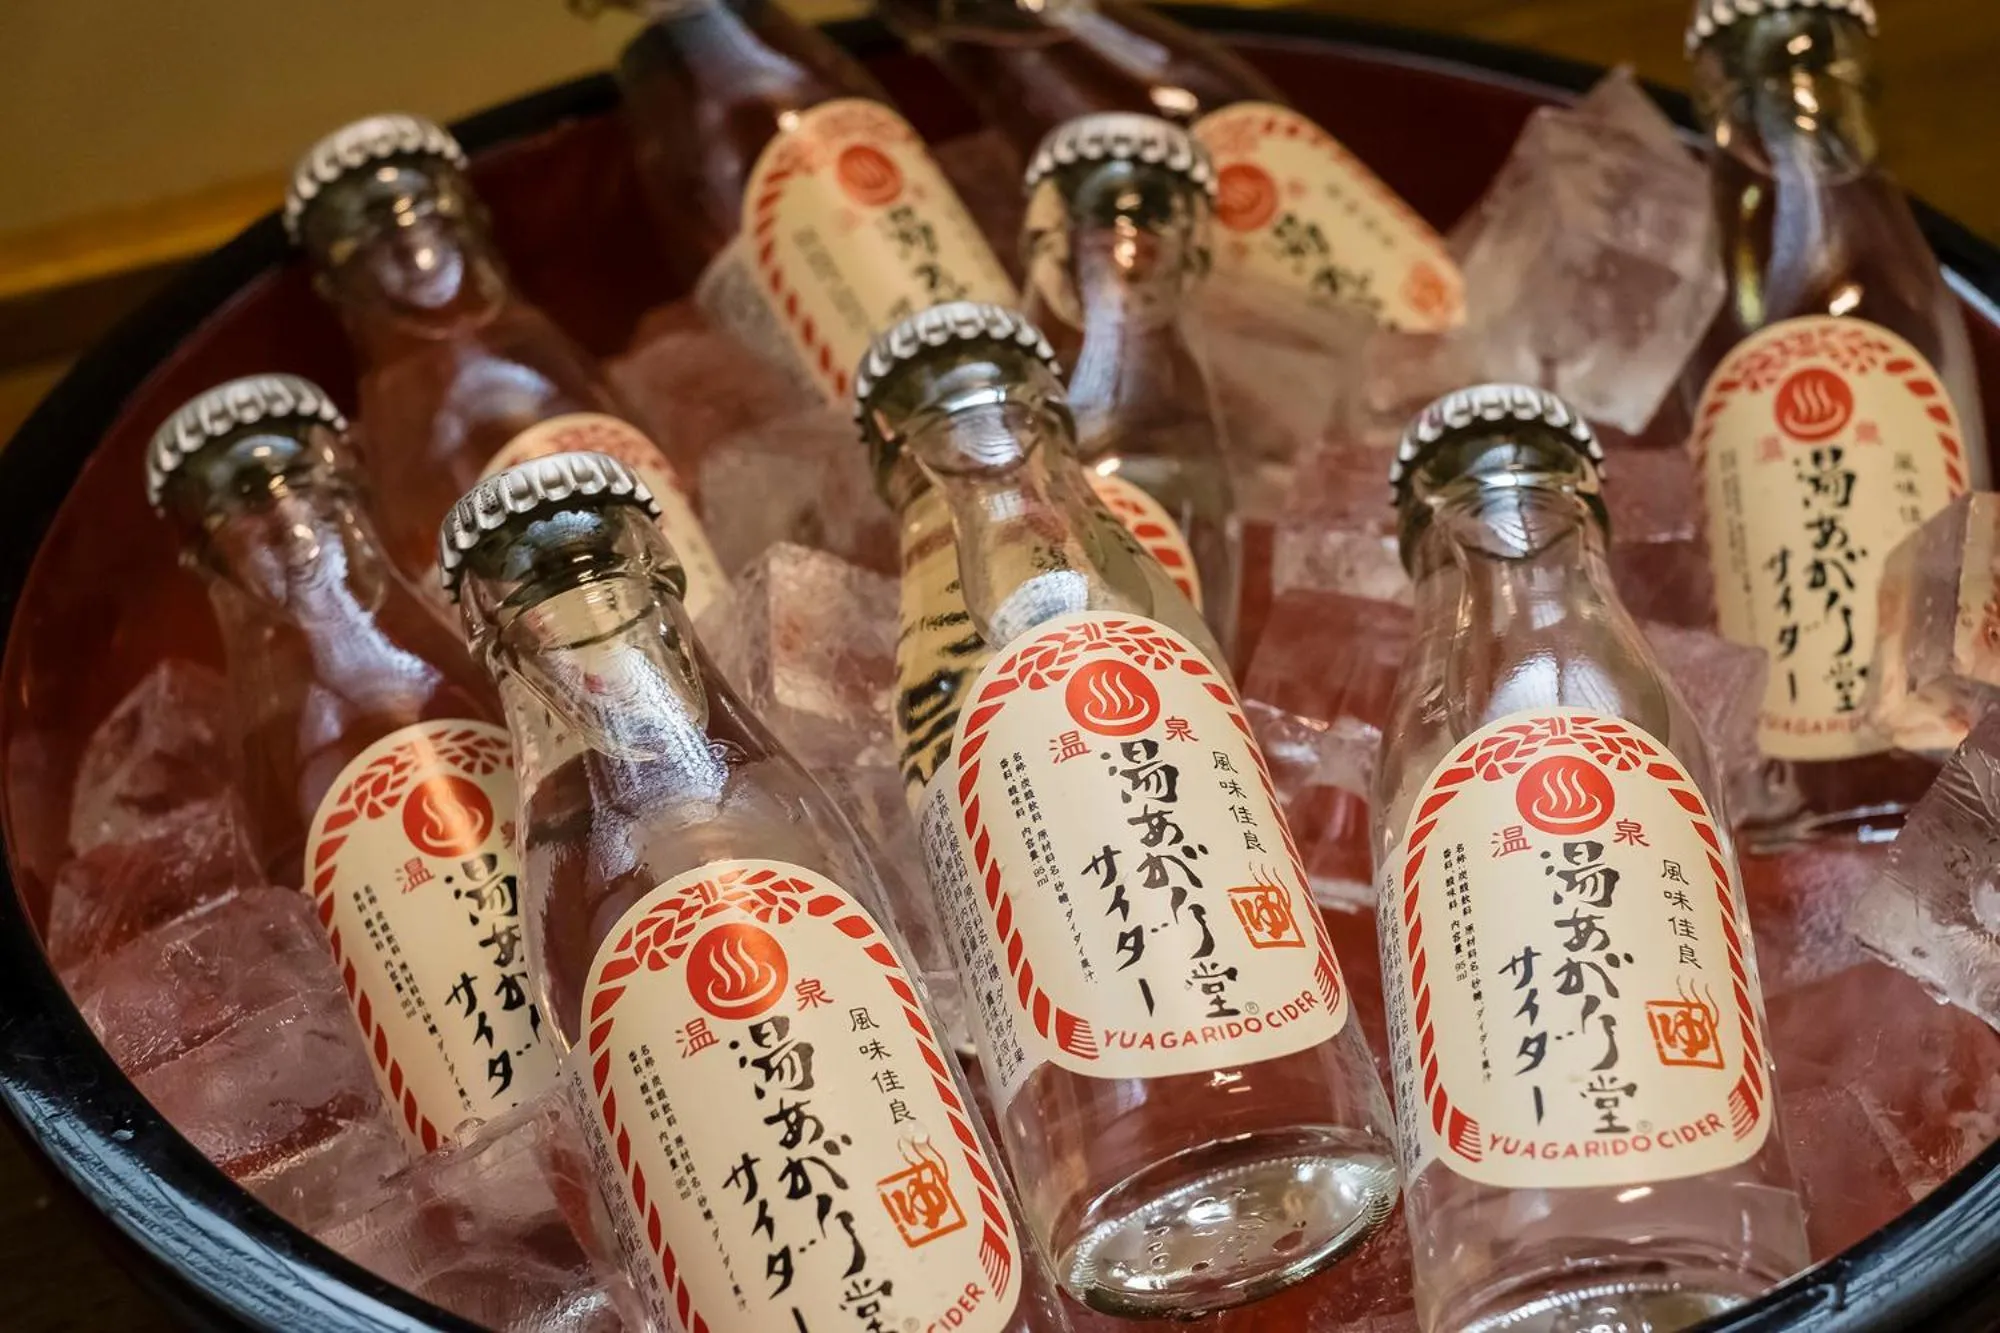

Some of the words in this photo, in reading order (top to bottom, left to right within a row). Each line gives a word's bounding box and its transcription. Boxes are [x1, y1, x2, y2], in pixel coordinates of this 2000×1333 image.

[1049, 729, 1091, 765] 温
[1164, 716, 1200, 744] 泉
[1212, 751, 1267, 853] 風味佳良
[1490, 825, 1533, 859] 温
[1613, 818, 1651, 848] 泉
[396, 857, 435, 895] 温
[1101, 739, 1240, 1019] 湯あがり堂
[1661, 858, 1703, 970] 風味佳良
[1081, 844, 1170, 1017] サイダー
[675, 1018, 720, 1059] 温
[794, 978, 835, 1012] 泉
[1104, 1017, 1262, 1050] YUAGARIDO
[1266, 990, 1319, 1028] CIDER
[1499, 946, 1575, 1126] サイダー
[1539, 840, 1638, 1135] 湯あがり堂
[849, 1007, 916, 1125] 風味佳良
[1488, 1133, 1652, 1160] YUAGARIDO
[1656, 1112, 1725, 1149] CIDER
